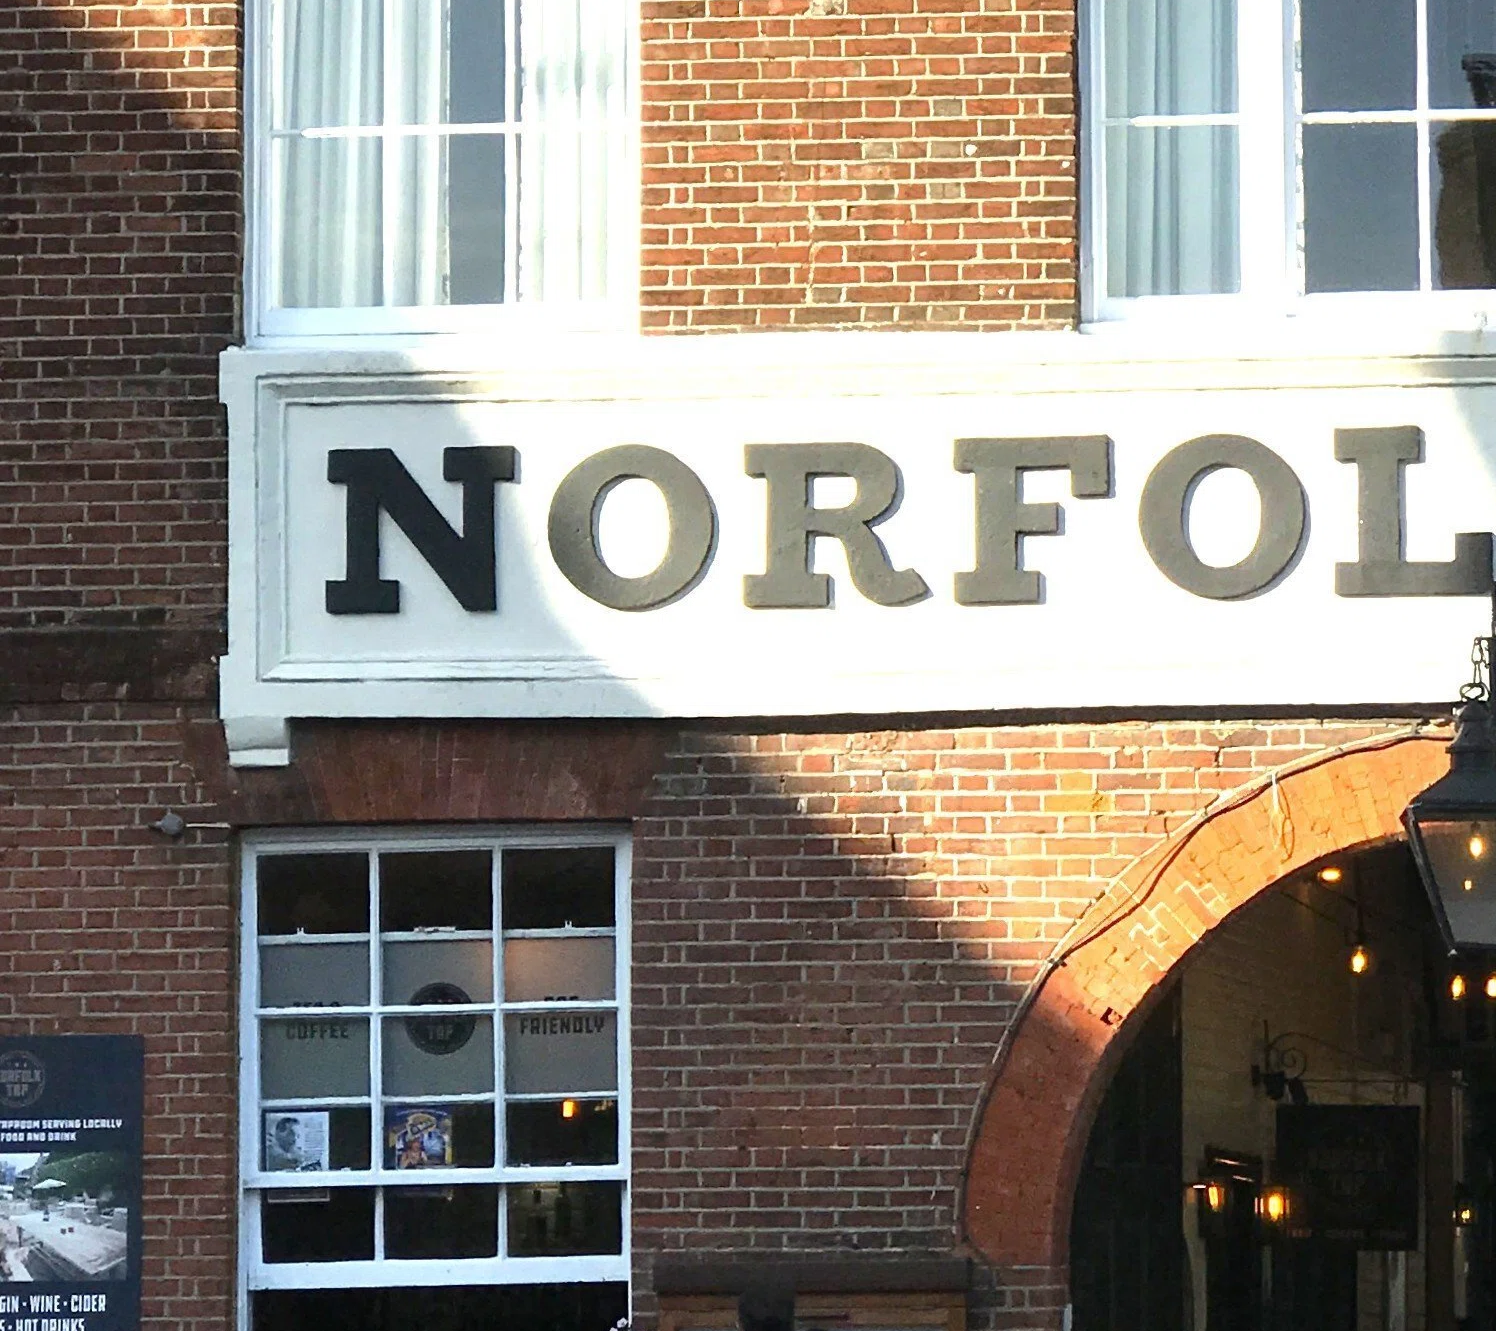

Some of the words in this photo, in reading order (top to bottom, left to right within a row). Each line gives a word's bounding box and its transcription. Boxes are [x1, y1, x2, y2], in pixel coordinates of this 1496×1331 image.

[285, 1022, 349, 1040] COFFEE
[520, 1015, 606, 1035] FRIENDLY
[41, 1119, 82, 1130] SERVING
[83, 1118, 122, 1129] LOCALLY
[1, 1131, 25, 1142] FOOD
[26, 1131, 46, 1142] AND
[47, 1131, 77, 1142] DRINK
[0, 1295, 20, 1314] GIN
[29, 1295, 61, 1313] WINE
[70, 1294, 106, 1313] CIDER
